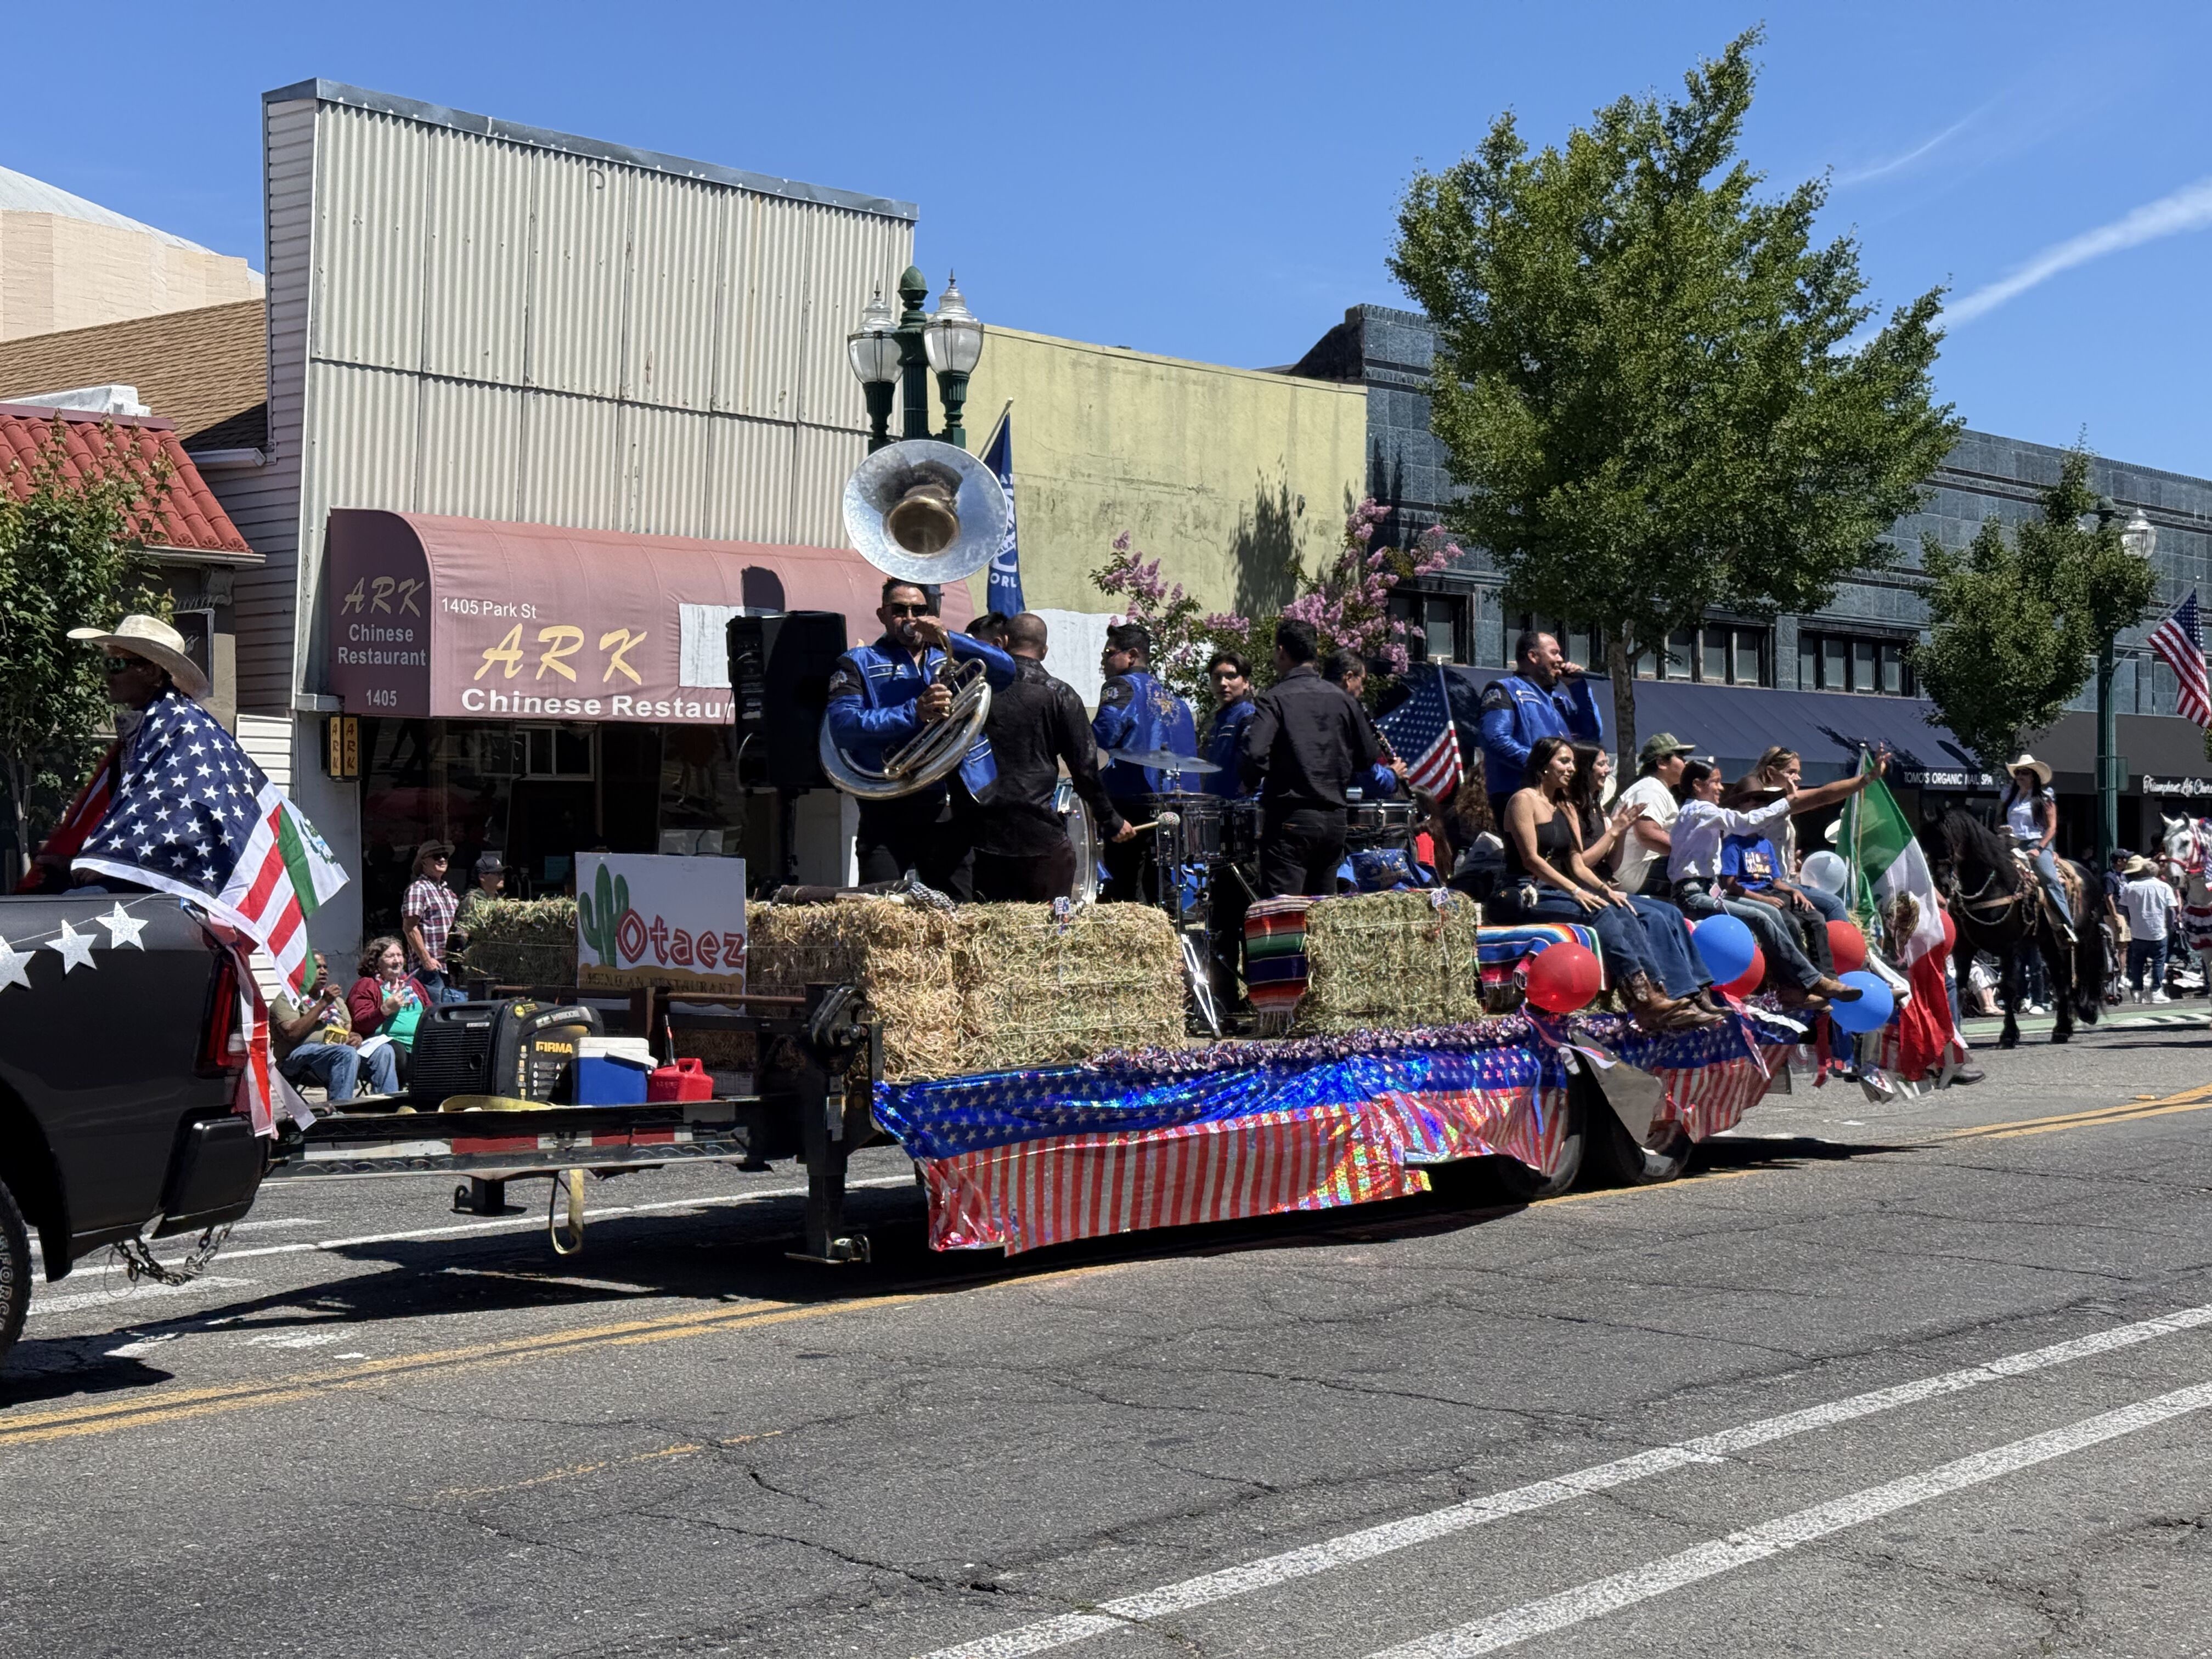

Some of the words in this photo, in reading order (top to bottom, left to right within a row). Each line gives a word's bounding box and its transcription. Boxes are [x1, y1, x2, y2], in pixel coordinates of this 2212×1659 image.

[341, 577, 425, 618] ARK
[442, 597, 478, 615] 1405
[483, 601, 517, 618] Park
[521, 603, 537, 619] St
[349, 624, 414, 642] Chinese
[338, 646, 426, 666] Restaurant
[474, 623, 647, 685] ARK
[366, 689, 397, 707] 1405
[461, 688, 601, 715] Chinese
[346, 723, 356, 769] ARK
[1904, 771, 1930, 784] TOMO'S
[1932, 772, 1963, 785] ORGANIC
[1965, 774, 1979, 786] NAIL
[1980, 774, 1994, 786] SPA
[616, 909, 746, 970] Otaez
